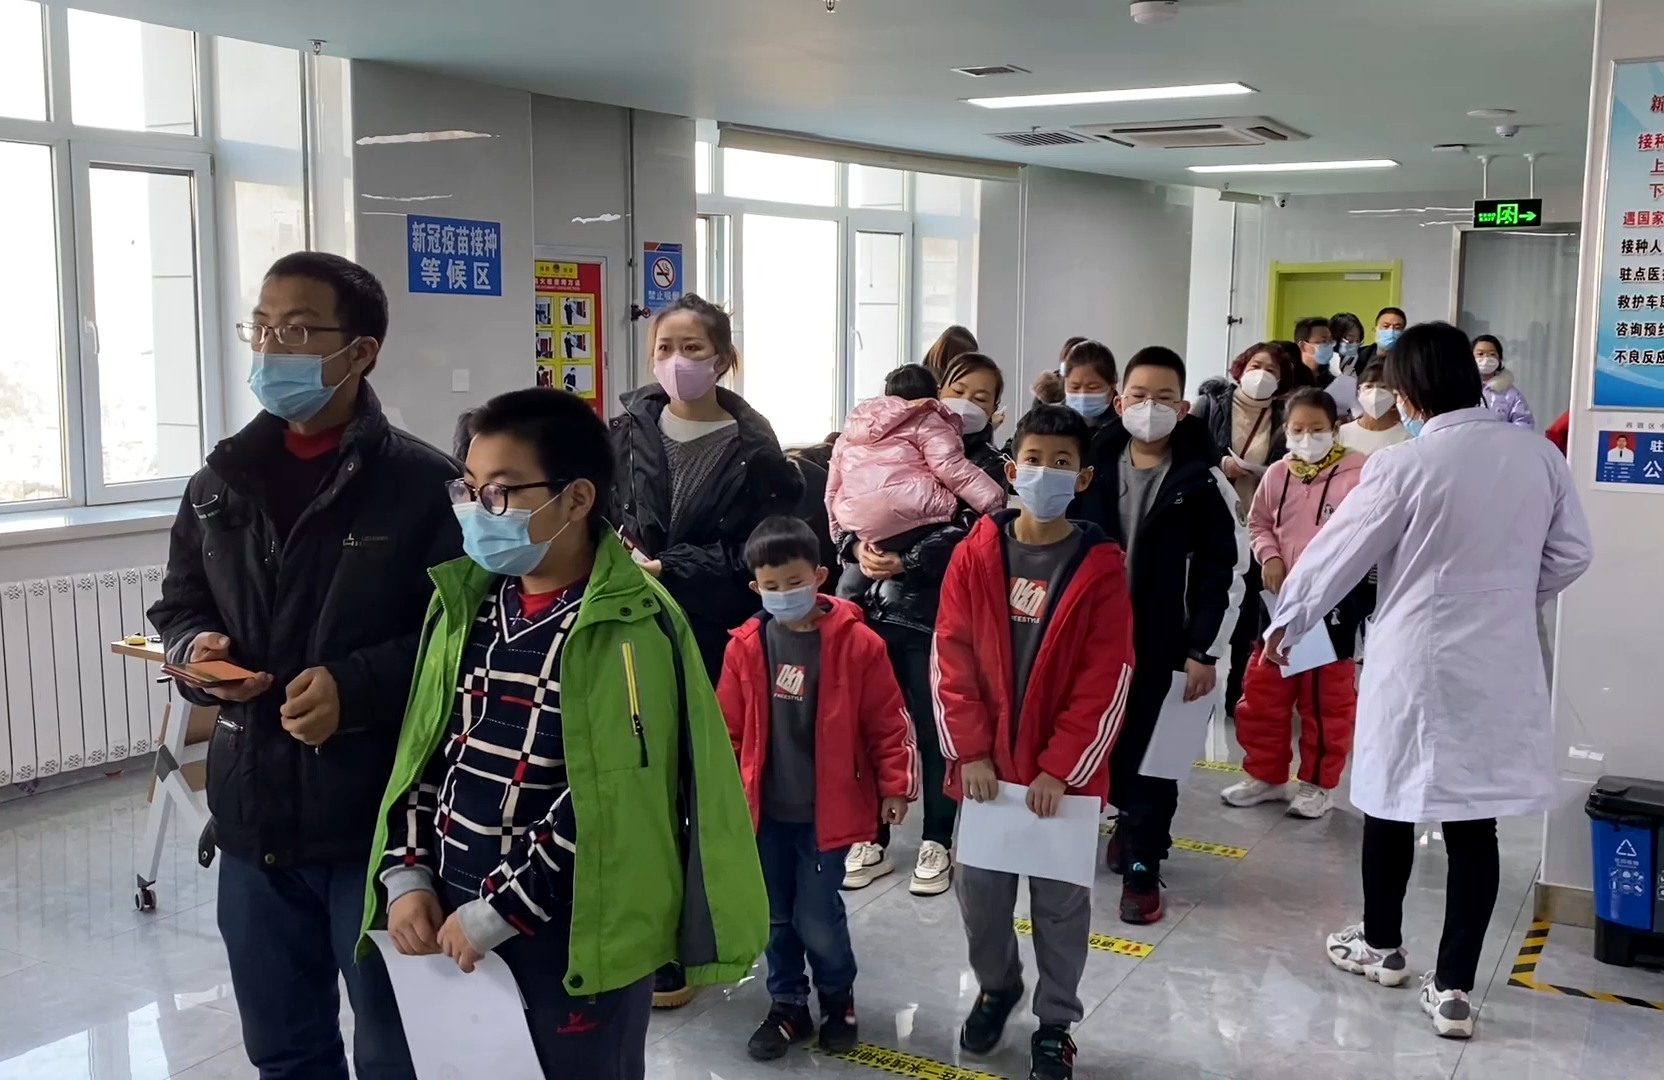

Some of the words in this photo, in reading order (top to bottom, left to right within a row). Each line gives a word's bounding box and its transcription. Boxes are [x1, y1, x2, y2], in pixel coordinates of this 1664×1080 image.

[1650, 95, 1664, 112] 新
[1638, 133, 1664, 149] 接种
[1650, 158, 1664, 173] 上
[1649, 183, 1664, 198] 下
[1623, 211, 1664, 226] 遇国家
[411, 221, 498, 258] 新冠疫苗接种
[1621, 239, 1662, 254] 接种人
[420, 257, 491, 289] 等候区
[1619, 267, 1664, 281] 驻点医
[1643, 460, 1663, 479] 公
[1011, 615, 1040, 624] REESTYLE
